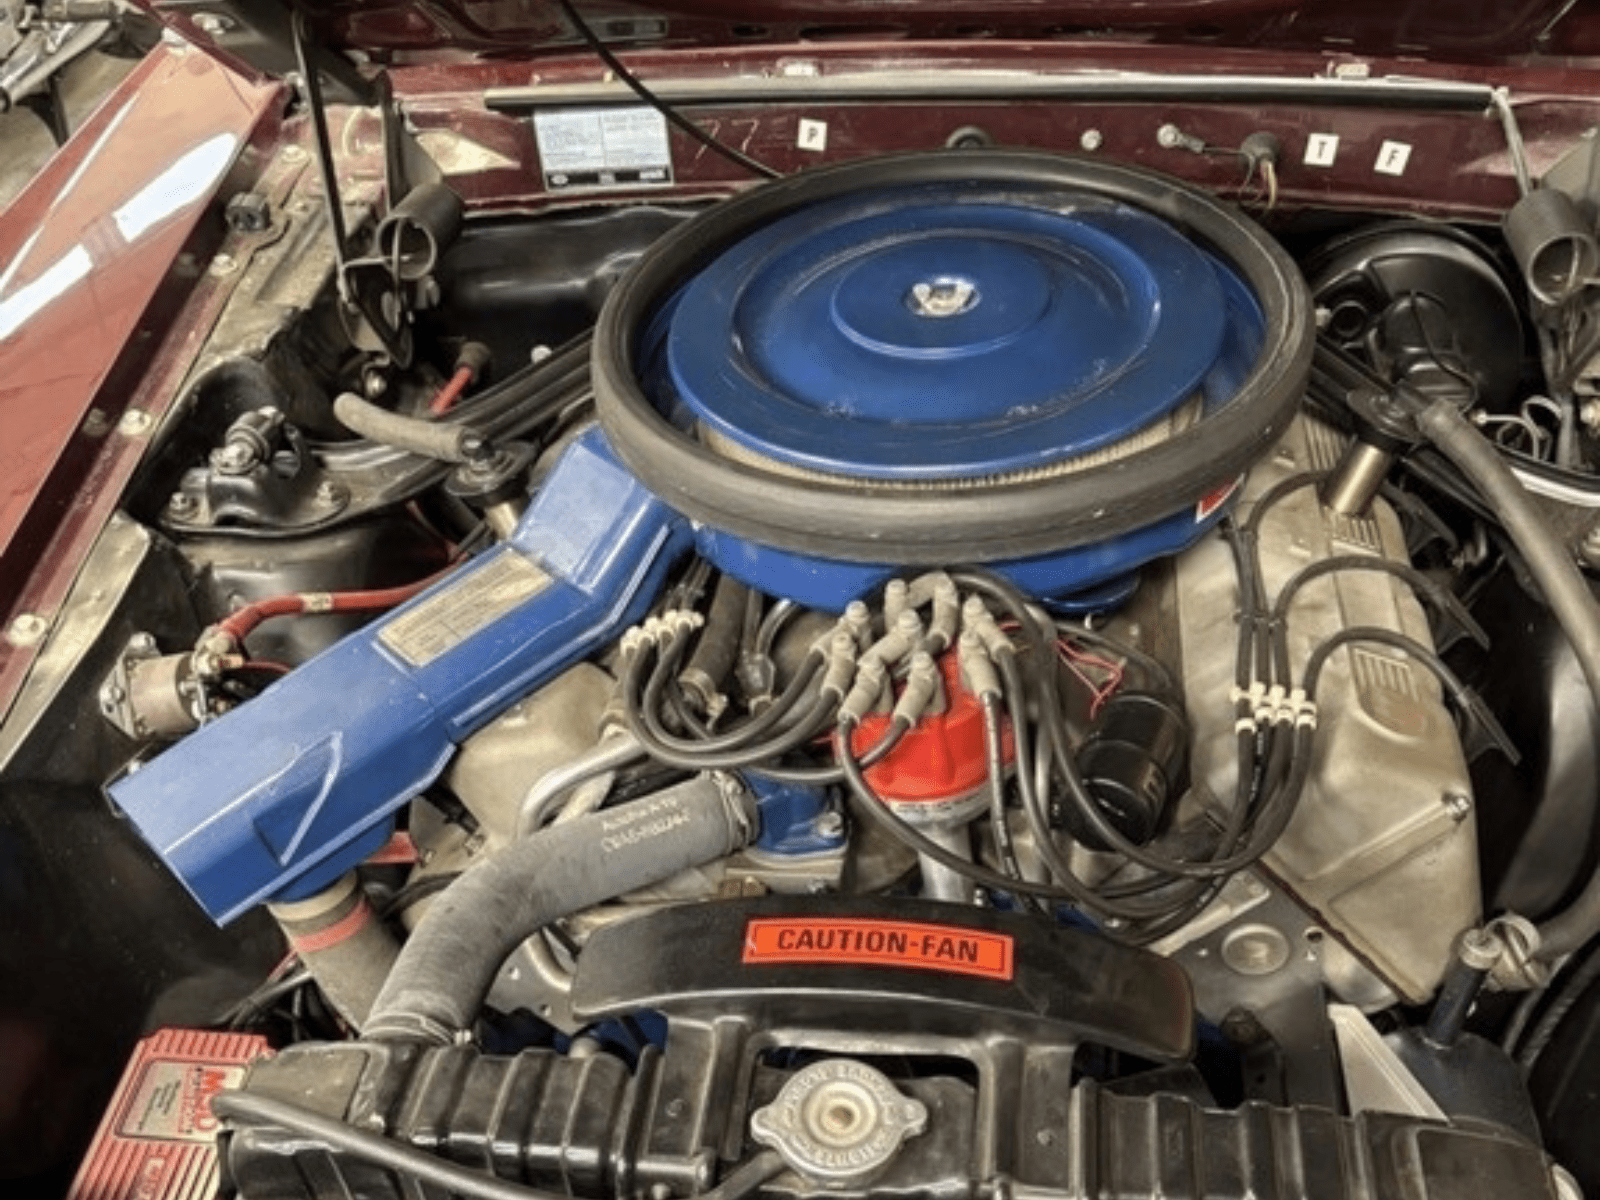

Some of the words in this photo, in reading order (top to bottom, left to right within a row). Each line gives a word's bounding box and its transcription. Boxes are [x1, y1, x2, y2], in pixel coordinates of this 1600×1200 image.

[806, 126, 819, 143] P
[1317, 140, 1328, 159] T
[1385, 148, 1400, 168] F
[777, 929, 979, 963] CAUTION-FAN
